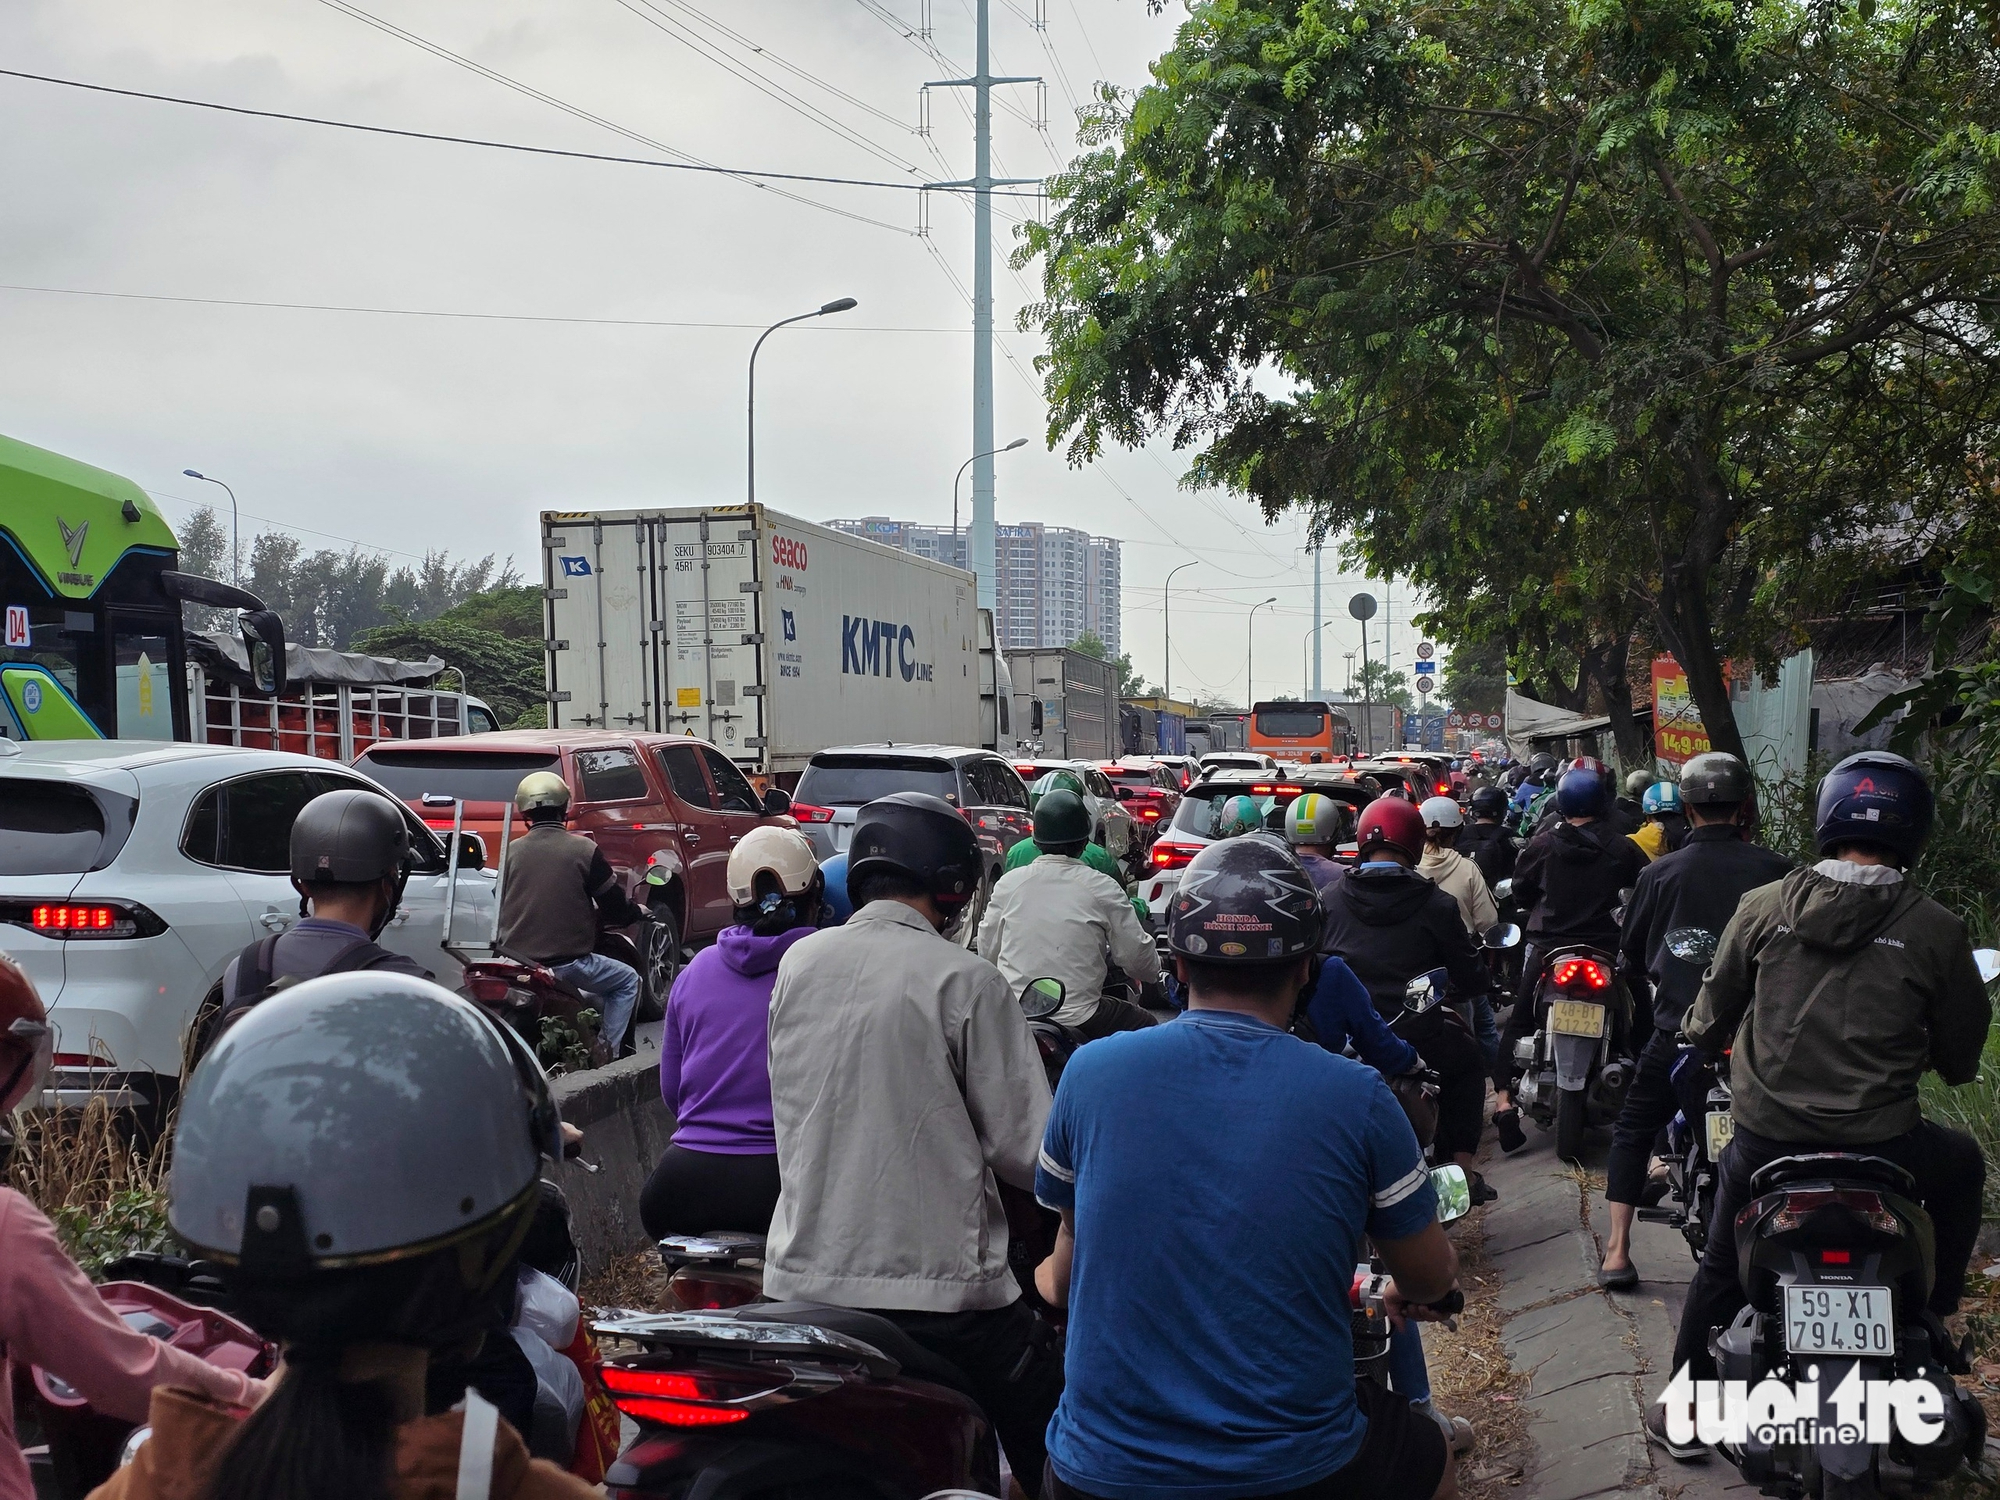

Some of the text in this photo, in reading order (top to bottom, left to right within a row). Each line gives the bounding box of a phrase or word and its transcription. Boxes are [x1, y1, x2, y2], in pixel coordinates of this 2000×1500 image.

[995, 526, 1033, 539] SAFIRA
[674, 543, 745, 557] SEKU 903404 7
[772, 534, 808, 572] seaco
[568, 560, 585, 573] K
[674, 561, 693, 572] 45R1
[9, 609, 26, 644] D4
[842, 614, 916, 683] KMTC
[916, 662, 933, 683] LINE
[1490, 717, 1499, 726] 50
[1216, 913, 1260, 923] HONDA
[1236, 922, 1273, 931] MINH
[1560, 1002, 1596, 1020] 48-B1
[1555, 1017, 1600, 1035] 212.23
[1801, 1290, 1872, 1319] 59-X1
[1793, 1320, 1887, 1350] 794.90
